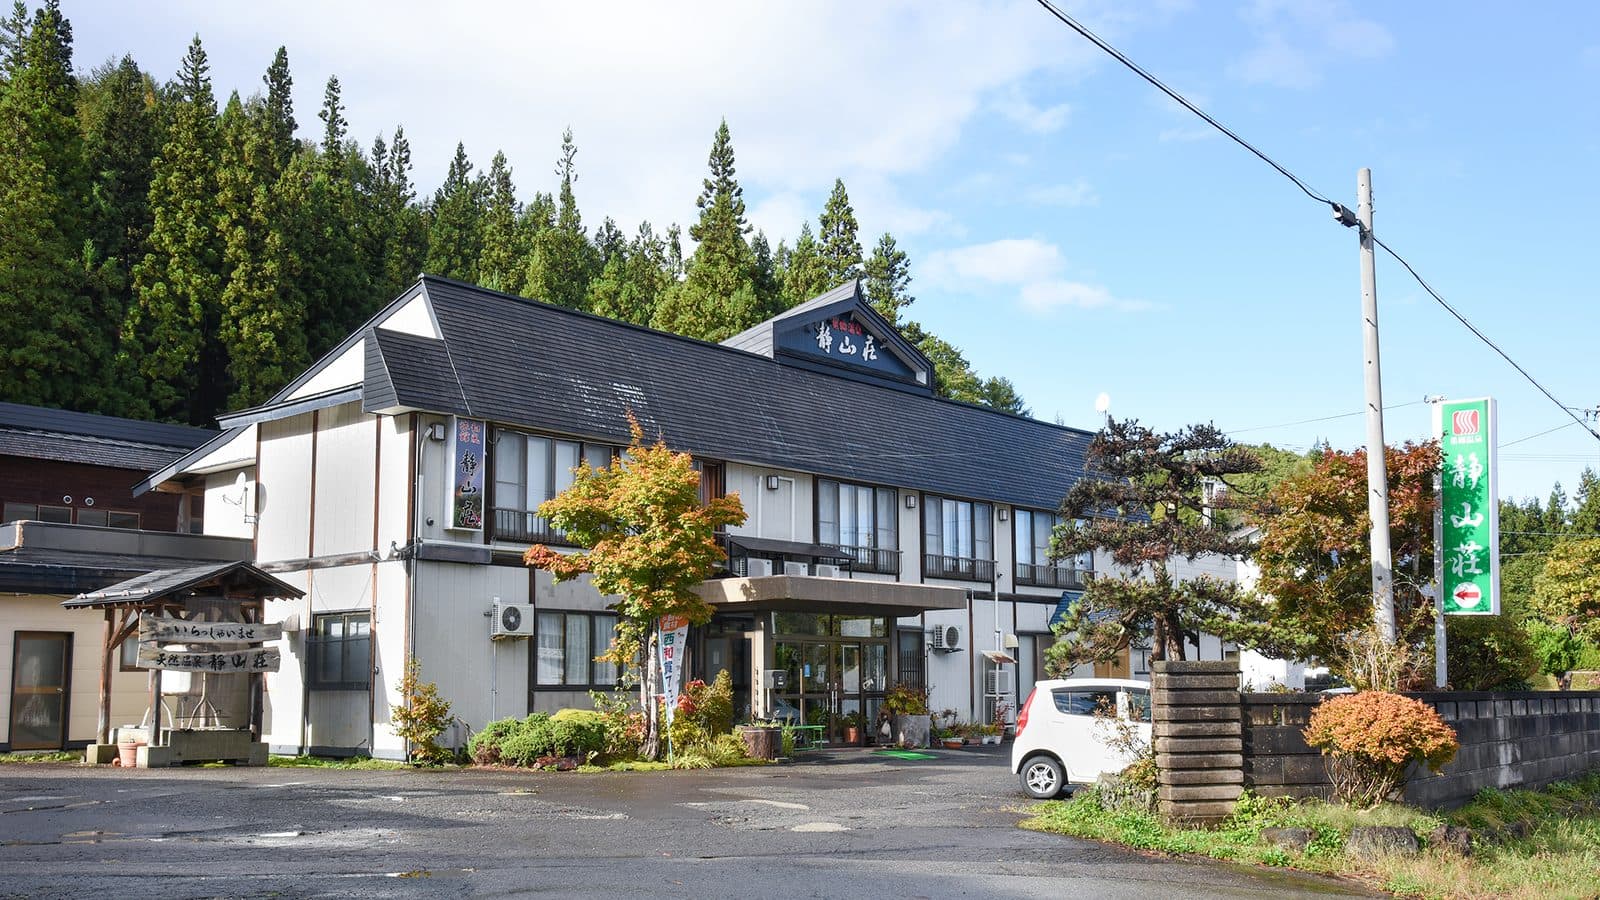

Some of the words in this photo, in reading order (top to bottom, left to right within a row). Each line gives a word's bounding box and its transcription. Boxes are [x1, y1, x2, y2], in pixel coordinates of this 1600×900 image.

[815, 321, 877, 361] 静山荘
[1449, 453, 1484, 577] 静山荘
[174, 625, 255, 639] いらっしゃいませ
[157, 653, 202, 667] 天然温泉
